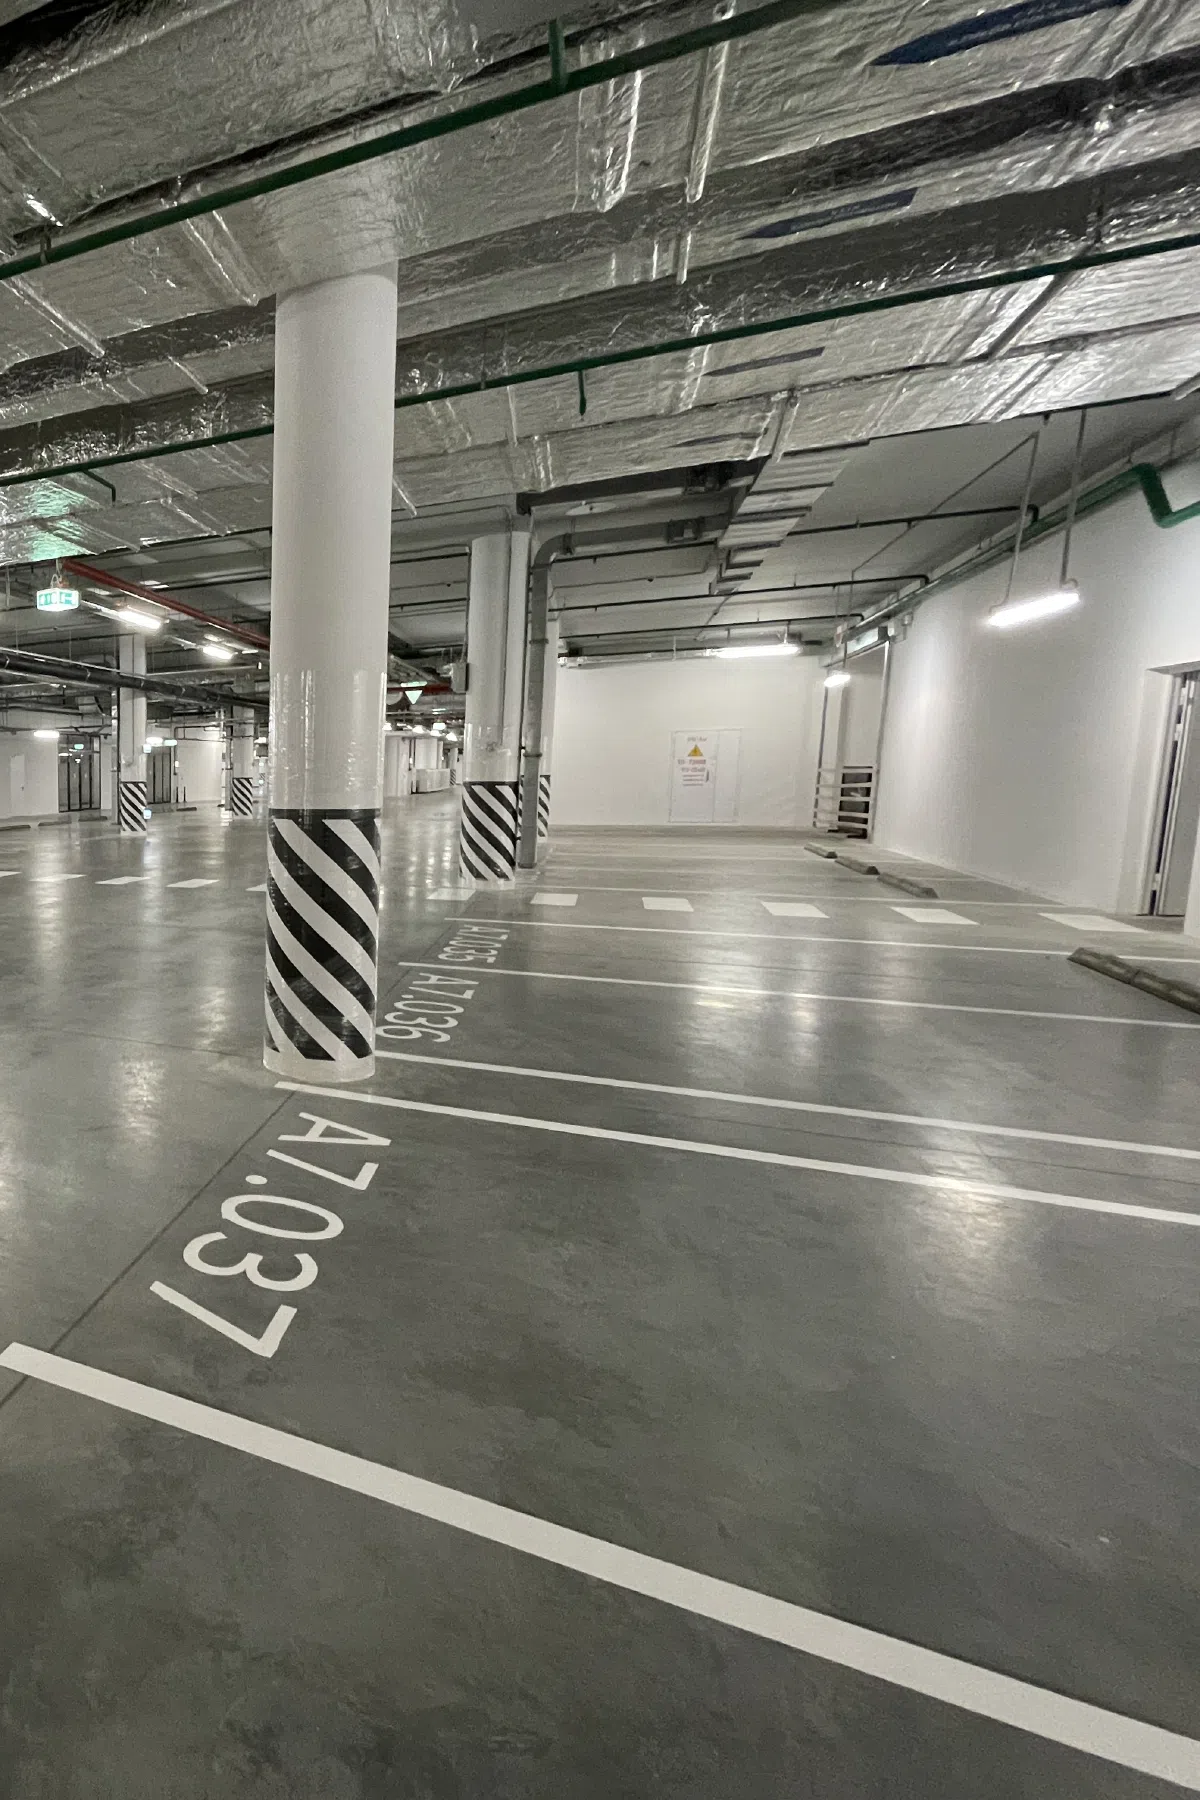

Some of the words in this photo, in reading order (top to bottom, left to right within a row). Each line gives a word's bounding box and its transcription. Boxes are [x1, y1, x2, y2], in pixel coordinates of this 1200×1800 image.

[438, 924, 510, 963] A7.035
[375, 973, 479, 1043] A7.036
[150, 1112, 392, 1358] A7.037
